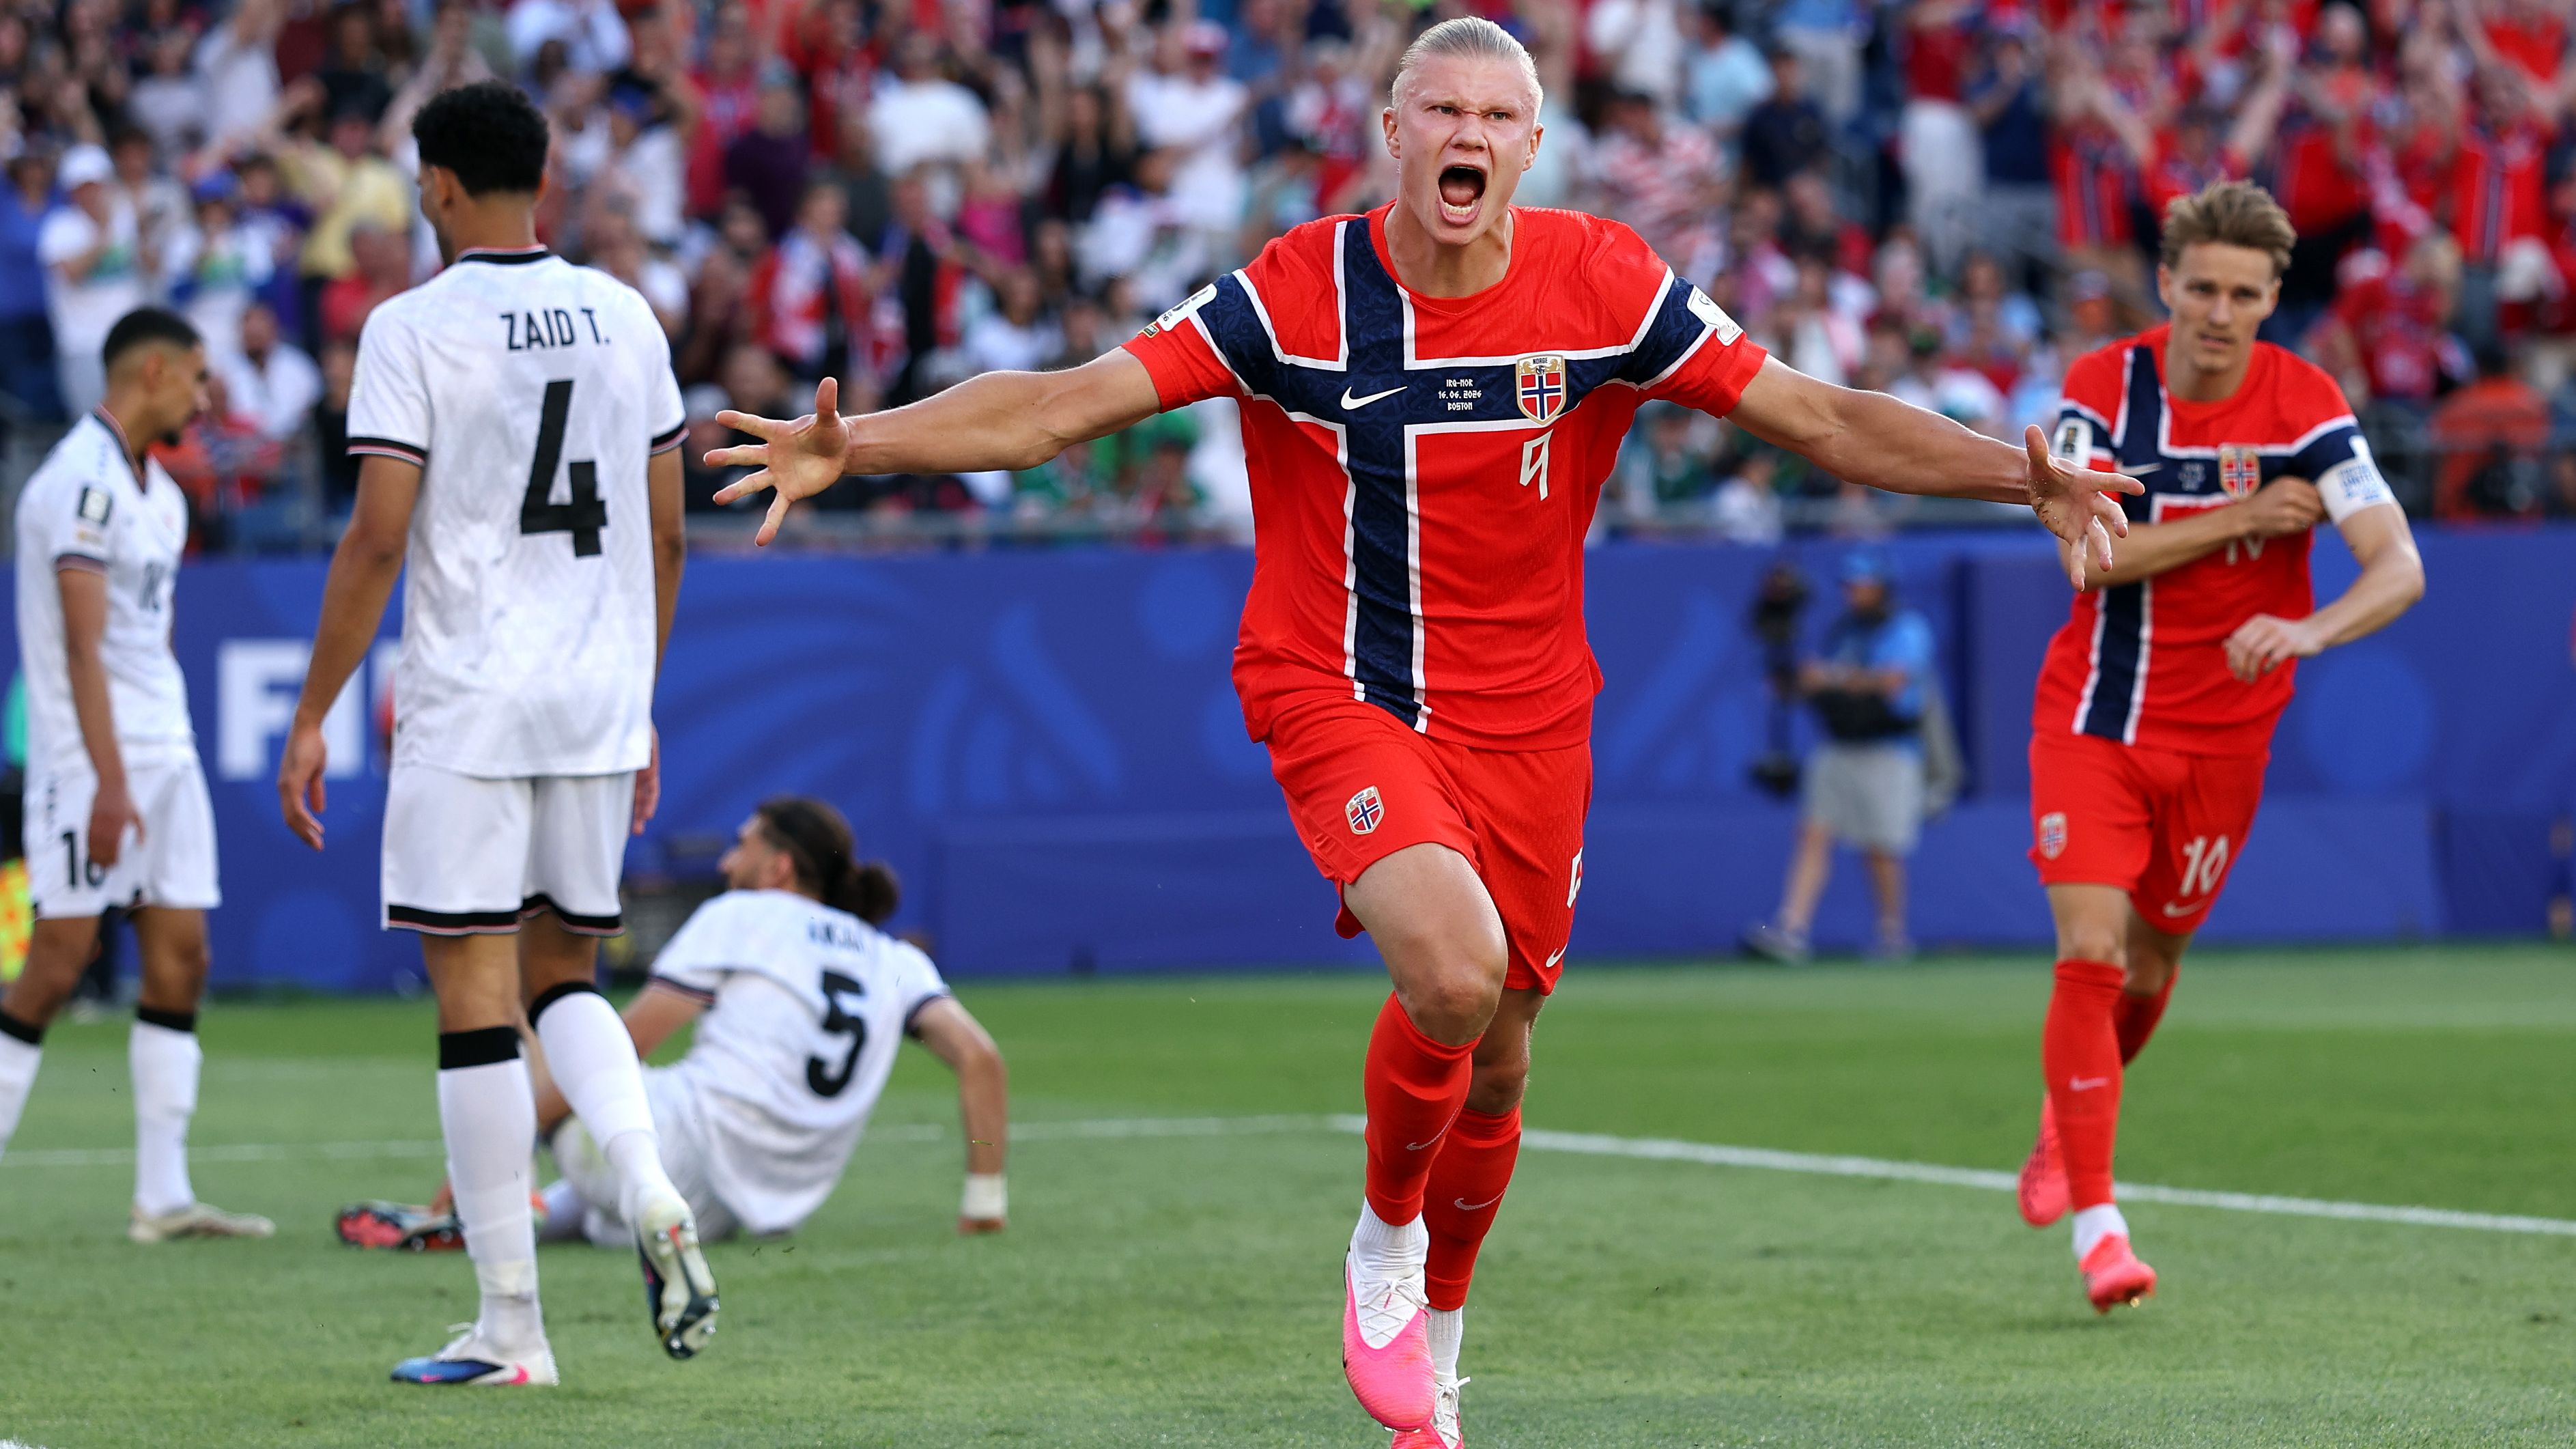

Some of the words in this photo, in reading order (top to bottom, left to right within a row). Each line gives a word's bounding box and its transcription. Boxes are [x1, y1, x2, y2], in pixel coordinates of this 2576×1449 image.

[500, 309, 576, 350] ZAID
[580, 307, 610, 345] T.
[1446, 378, 1473, 387] IRQ-NOR
[1447, 402, 1473, 410] BOSTON
[521, 380, 607, 557] 4
[1519, 428, 1554, 501] 9
[2182, 835, 2228, 897] 10
[807, 970, 866, 1097] 5
